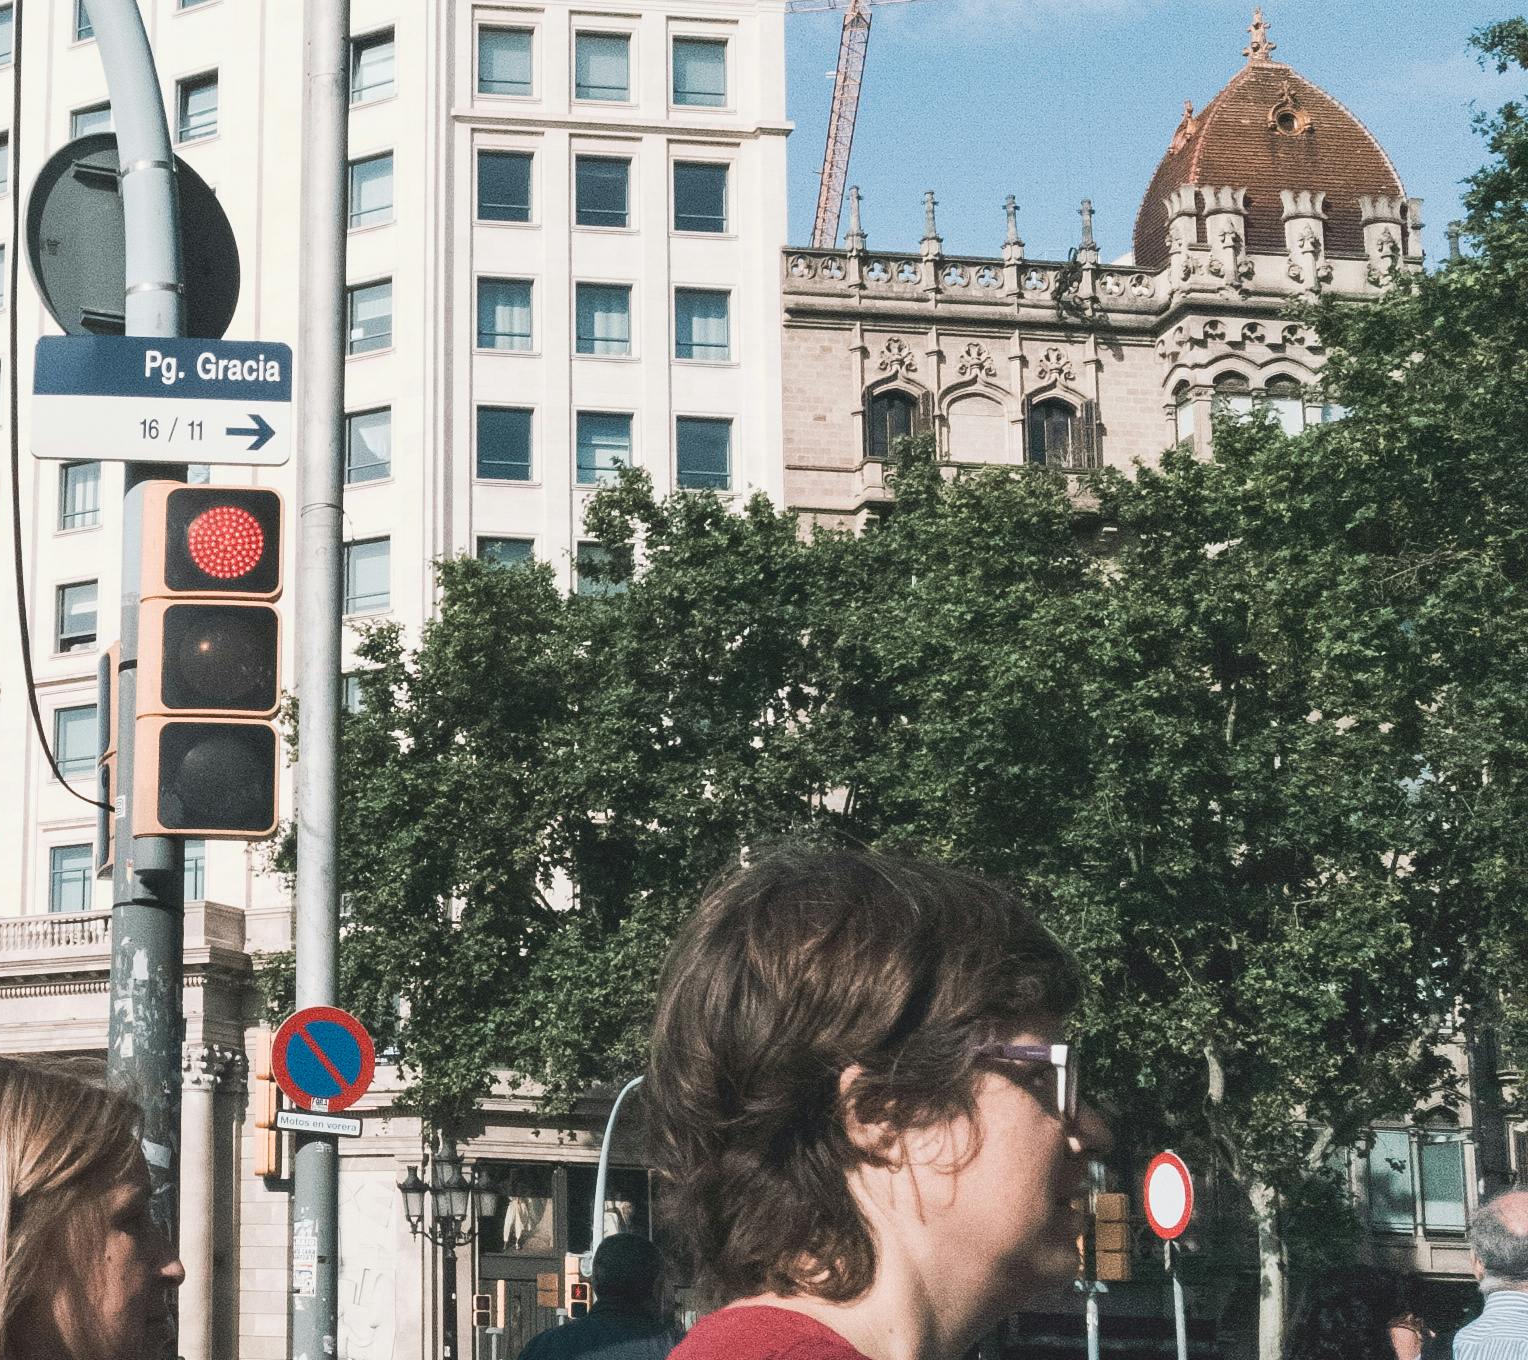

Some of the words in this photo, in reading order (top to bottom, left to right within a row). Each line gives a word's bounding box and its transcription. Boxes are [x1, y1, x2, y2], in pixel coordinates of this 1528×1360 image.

[144, 350, 185, 385] Pg.
[196, 351, 281, 382] Gracia
[139, 418, 160, 440] 16
[187, 420, 203, 441] 11
[280, 1115, 309, 1127] Motos
[312, 1120, 324, 1128] en
[327, 1121, 357, 1132] vorera
